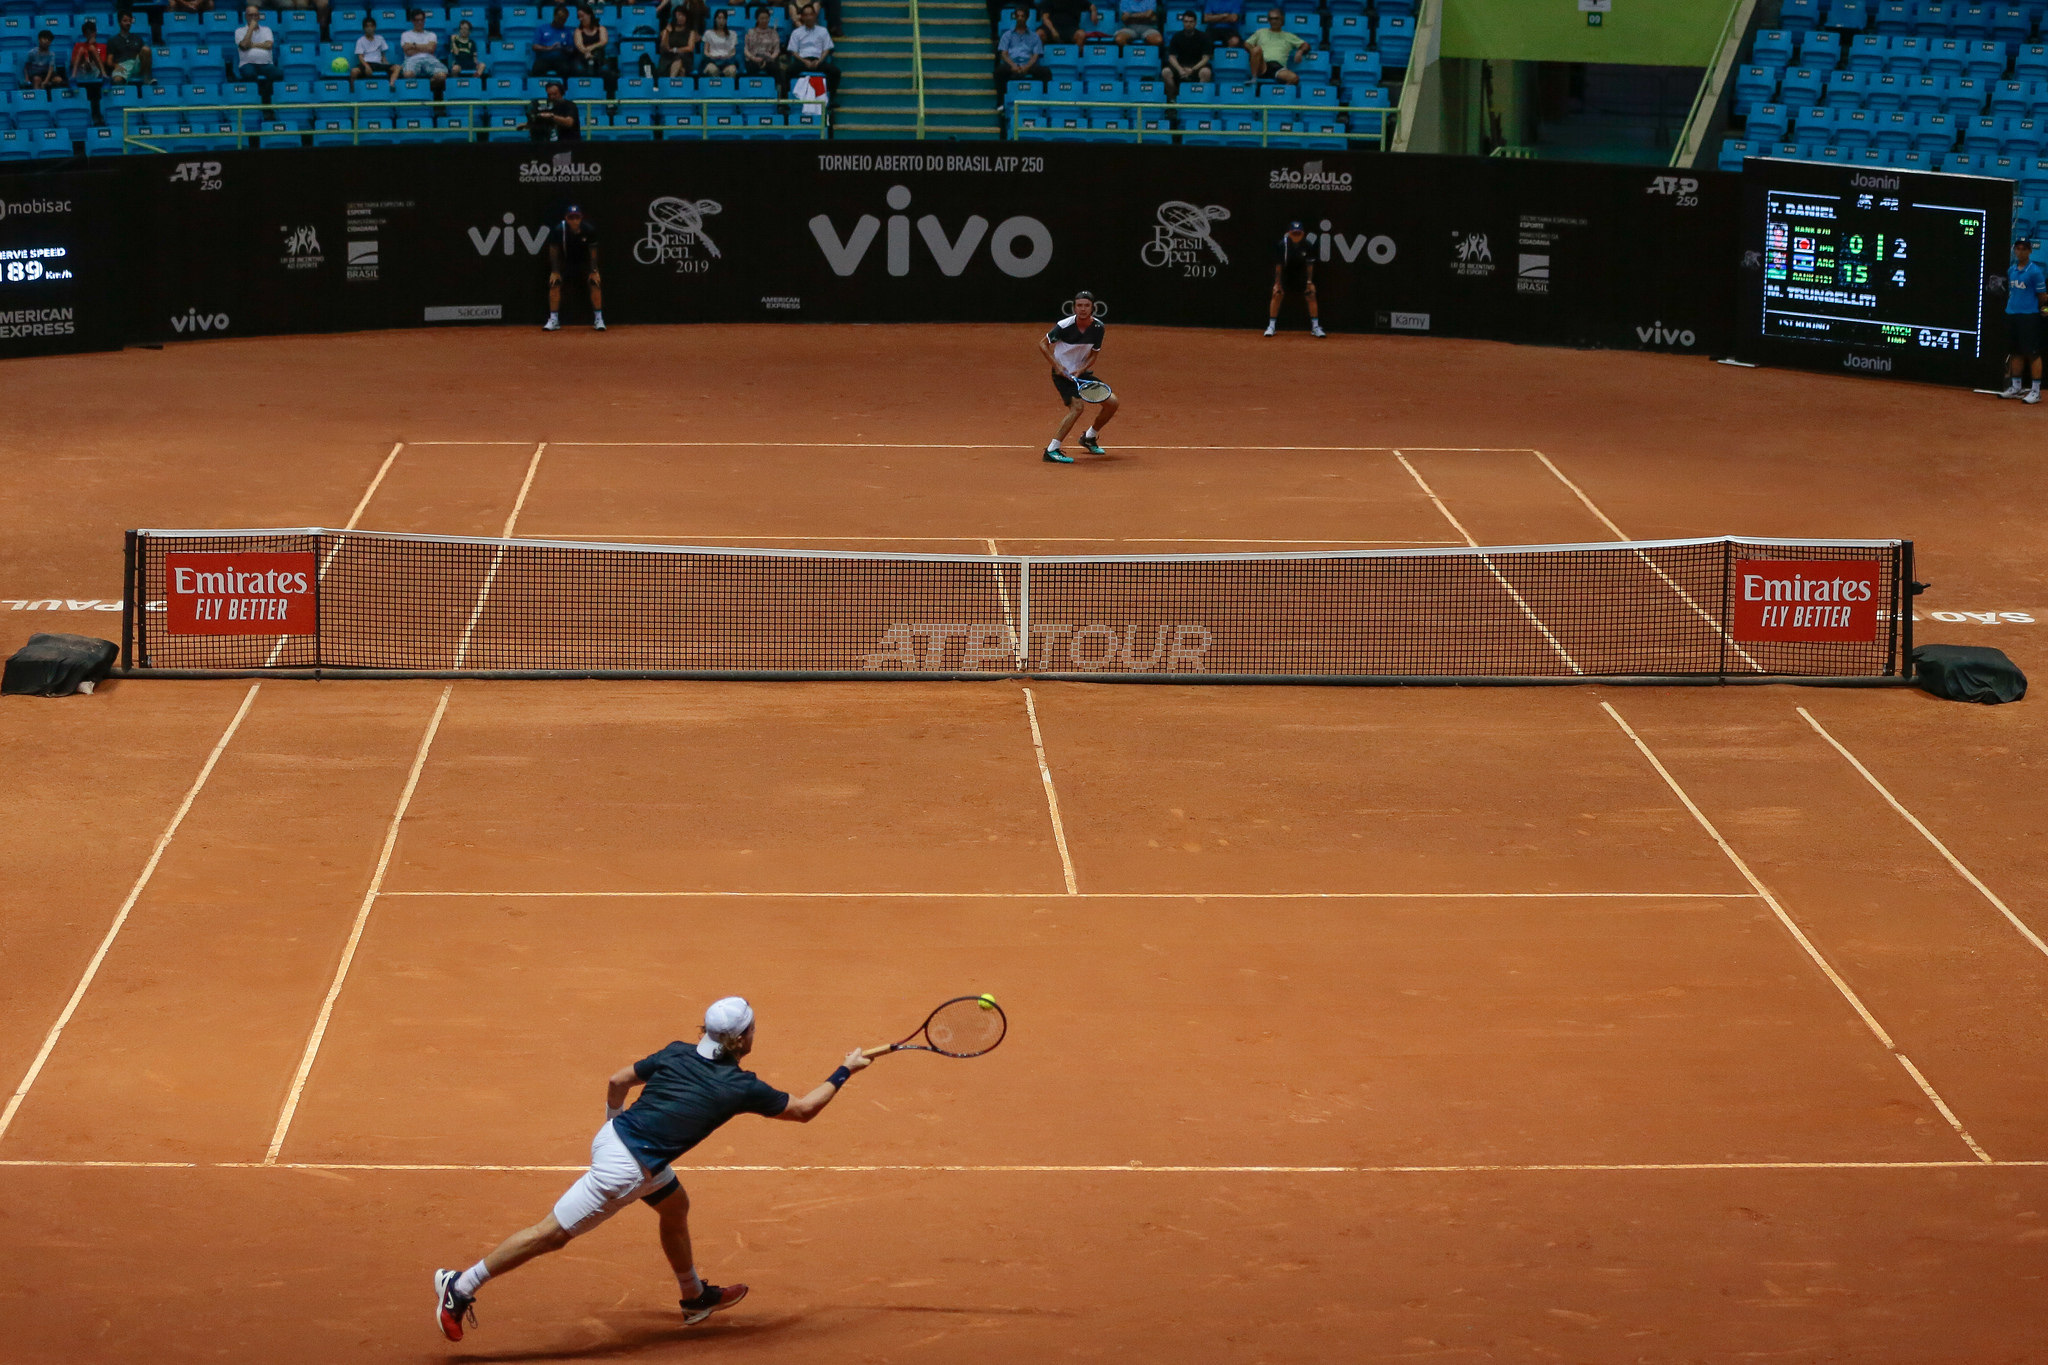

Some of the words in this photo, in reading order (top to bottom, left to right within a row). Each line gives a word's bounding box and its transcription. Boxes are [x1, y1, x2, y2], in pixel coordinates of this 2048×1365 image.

[169, 161, 222, 182] ATP
[519, 160, 550, 176] SÃO
[553, 163, 602, 176] PAULO
[818, 155, 872, 171] TORNEIO
[875, 155, 923, 171] ABERTO
[926, 155, 943, 171] DO
[947, 156, 992, 172] BRASIL
[995, 156, 1018, 172] ATP
[1022, 156, 1044, 173] 250
[201, 179, 222, 190] 250
[1270, 168, 1301, 184] SÃO
[1303, 171, 1352, 185] PAULO
[1646, 176, 1699, 196] ATP
[1851, 173, 1899, 191] Joanini
[8, 199, 72, 214] mobisac
[1676, 196, 1698, 207] 250
[1785, 203, 1837, 219] DANIEL
[467, 212, 550, 256] viv
[645, 222, 695, 249] Brasil
[808, 184, 1053, 278] vivo
[1152, 225, 1203, 251] Brasil
[634, 238, 690, 264] Open
[1307, 219, 1396, 264] ivo
[1849, 234, 1863, 254] 0
[1893, 238, 1908, 258] 2
[0, 250, 28, 261] ERVE
[30, 247, 66, 259] SPEED
[1141, 240, 1196, 267] Open
[347, 270, 378, 279] BRASIL
[676, 260, 709, 273] 2019
[1184, 264, 1217, 278] 2019
[1843, 264, 1868, 283] 15
[1517, 283, 1548, 292] BRASIL
[1891, 270, 1907, 287] 4
[1767, 285, 1784, 298] M.
[1786, 286, 1877, 307] TRUNGELLITI
[0, 308, 73, 324] MERICAN
[171, 308, 230, 333] vivo
[0, 322, 75, 338] EXPRESS
[1636, 321, 1696, 346] vivo
[1881, 325, 1912, 336] MATCH
[1919, 329, 1960, 350] 0:41
[1843, 354, 1892, 371] Joanini
[174, 566, 308, 594] Emirates
[1744, 574, 1871, 602] Emirates
[195, 599, 223, 620] FLY
[228, 598, 288, 620] BETTER
[1761, 606, 1789, 627] FLY
[1793, 606, 1851, 628] BETTER
[855, 623, 1012, 669] ATP
[1030, 624, 1212, 670] TOUR
